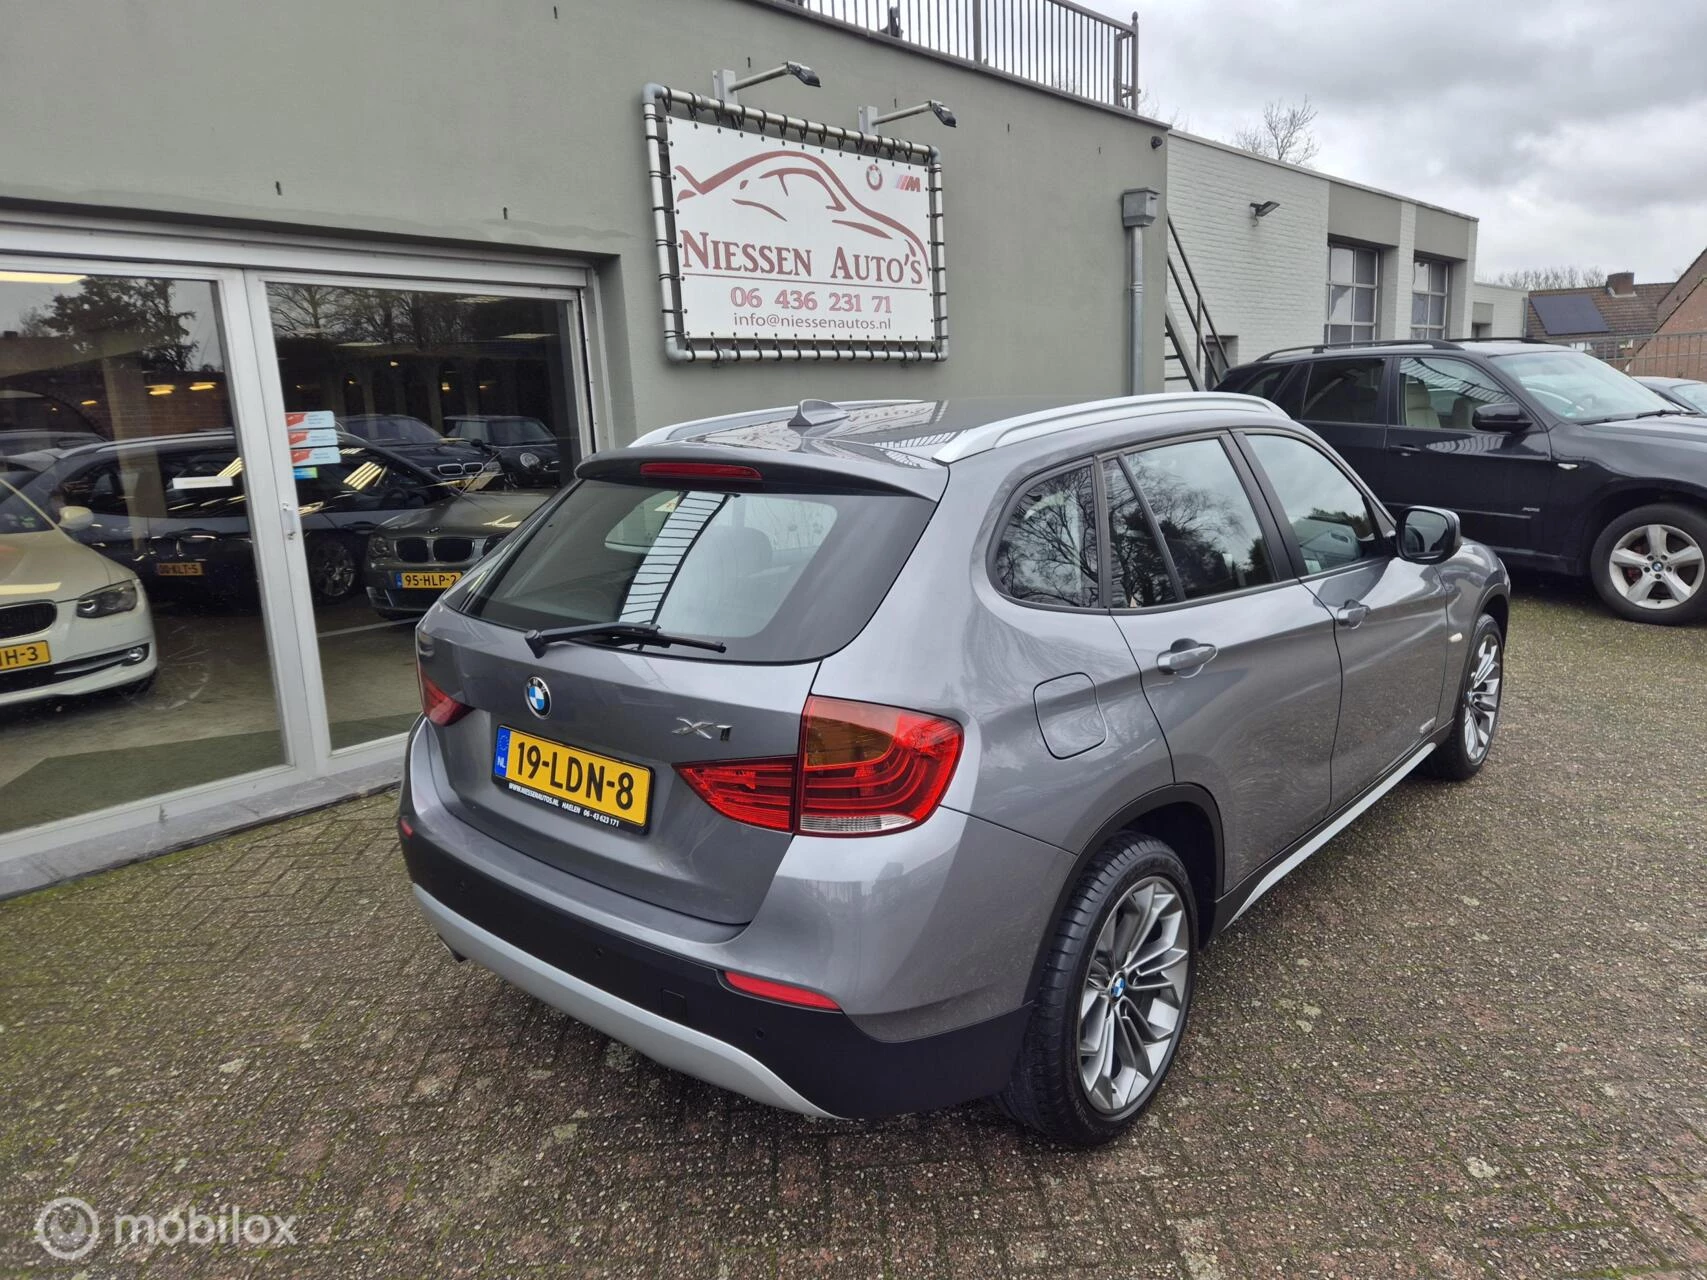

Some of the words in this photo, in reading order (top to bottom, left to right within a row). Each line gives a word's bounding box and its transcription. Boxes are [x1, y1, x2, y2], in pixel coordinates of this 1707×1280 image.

[680, 230, 811, 277] NIESSEN
[830, 246, 923, 285] AUTO'S
[730, 287, 762, 308] 06
[774, 289, 818, 311] 436
[829, 292, 862, 312] 231
[871, 295, 892, 313] 71
[733, 313, 892, 330] info@niessenautos.nl
[0, 646, 38, 666] H-3
[672, 716, 735, 742] X1
[496, 756, 507, 769] NL
[517, 741, 634, 810] 19-LDN-8
